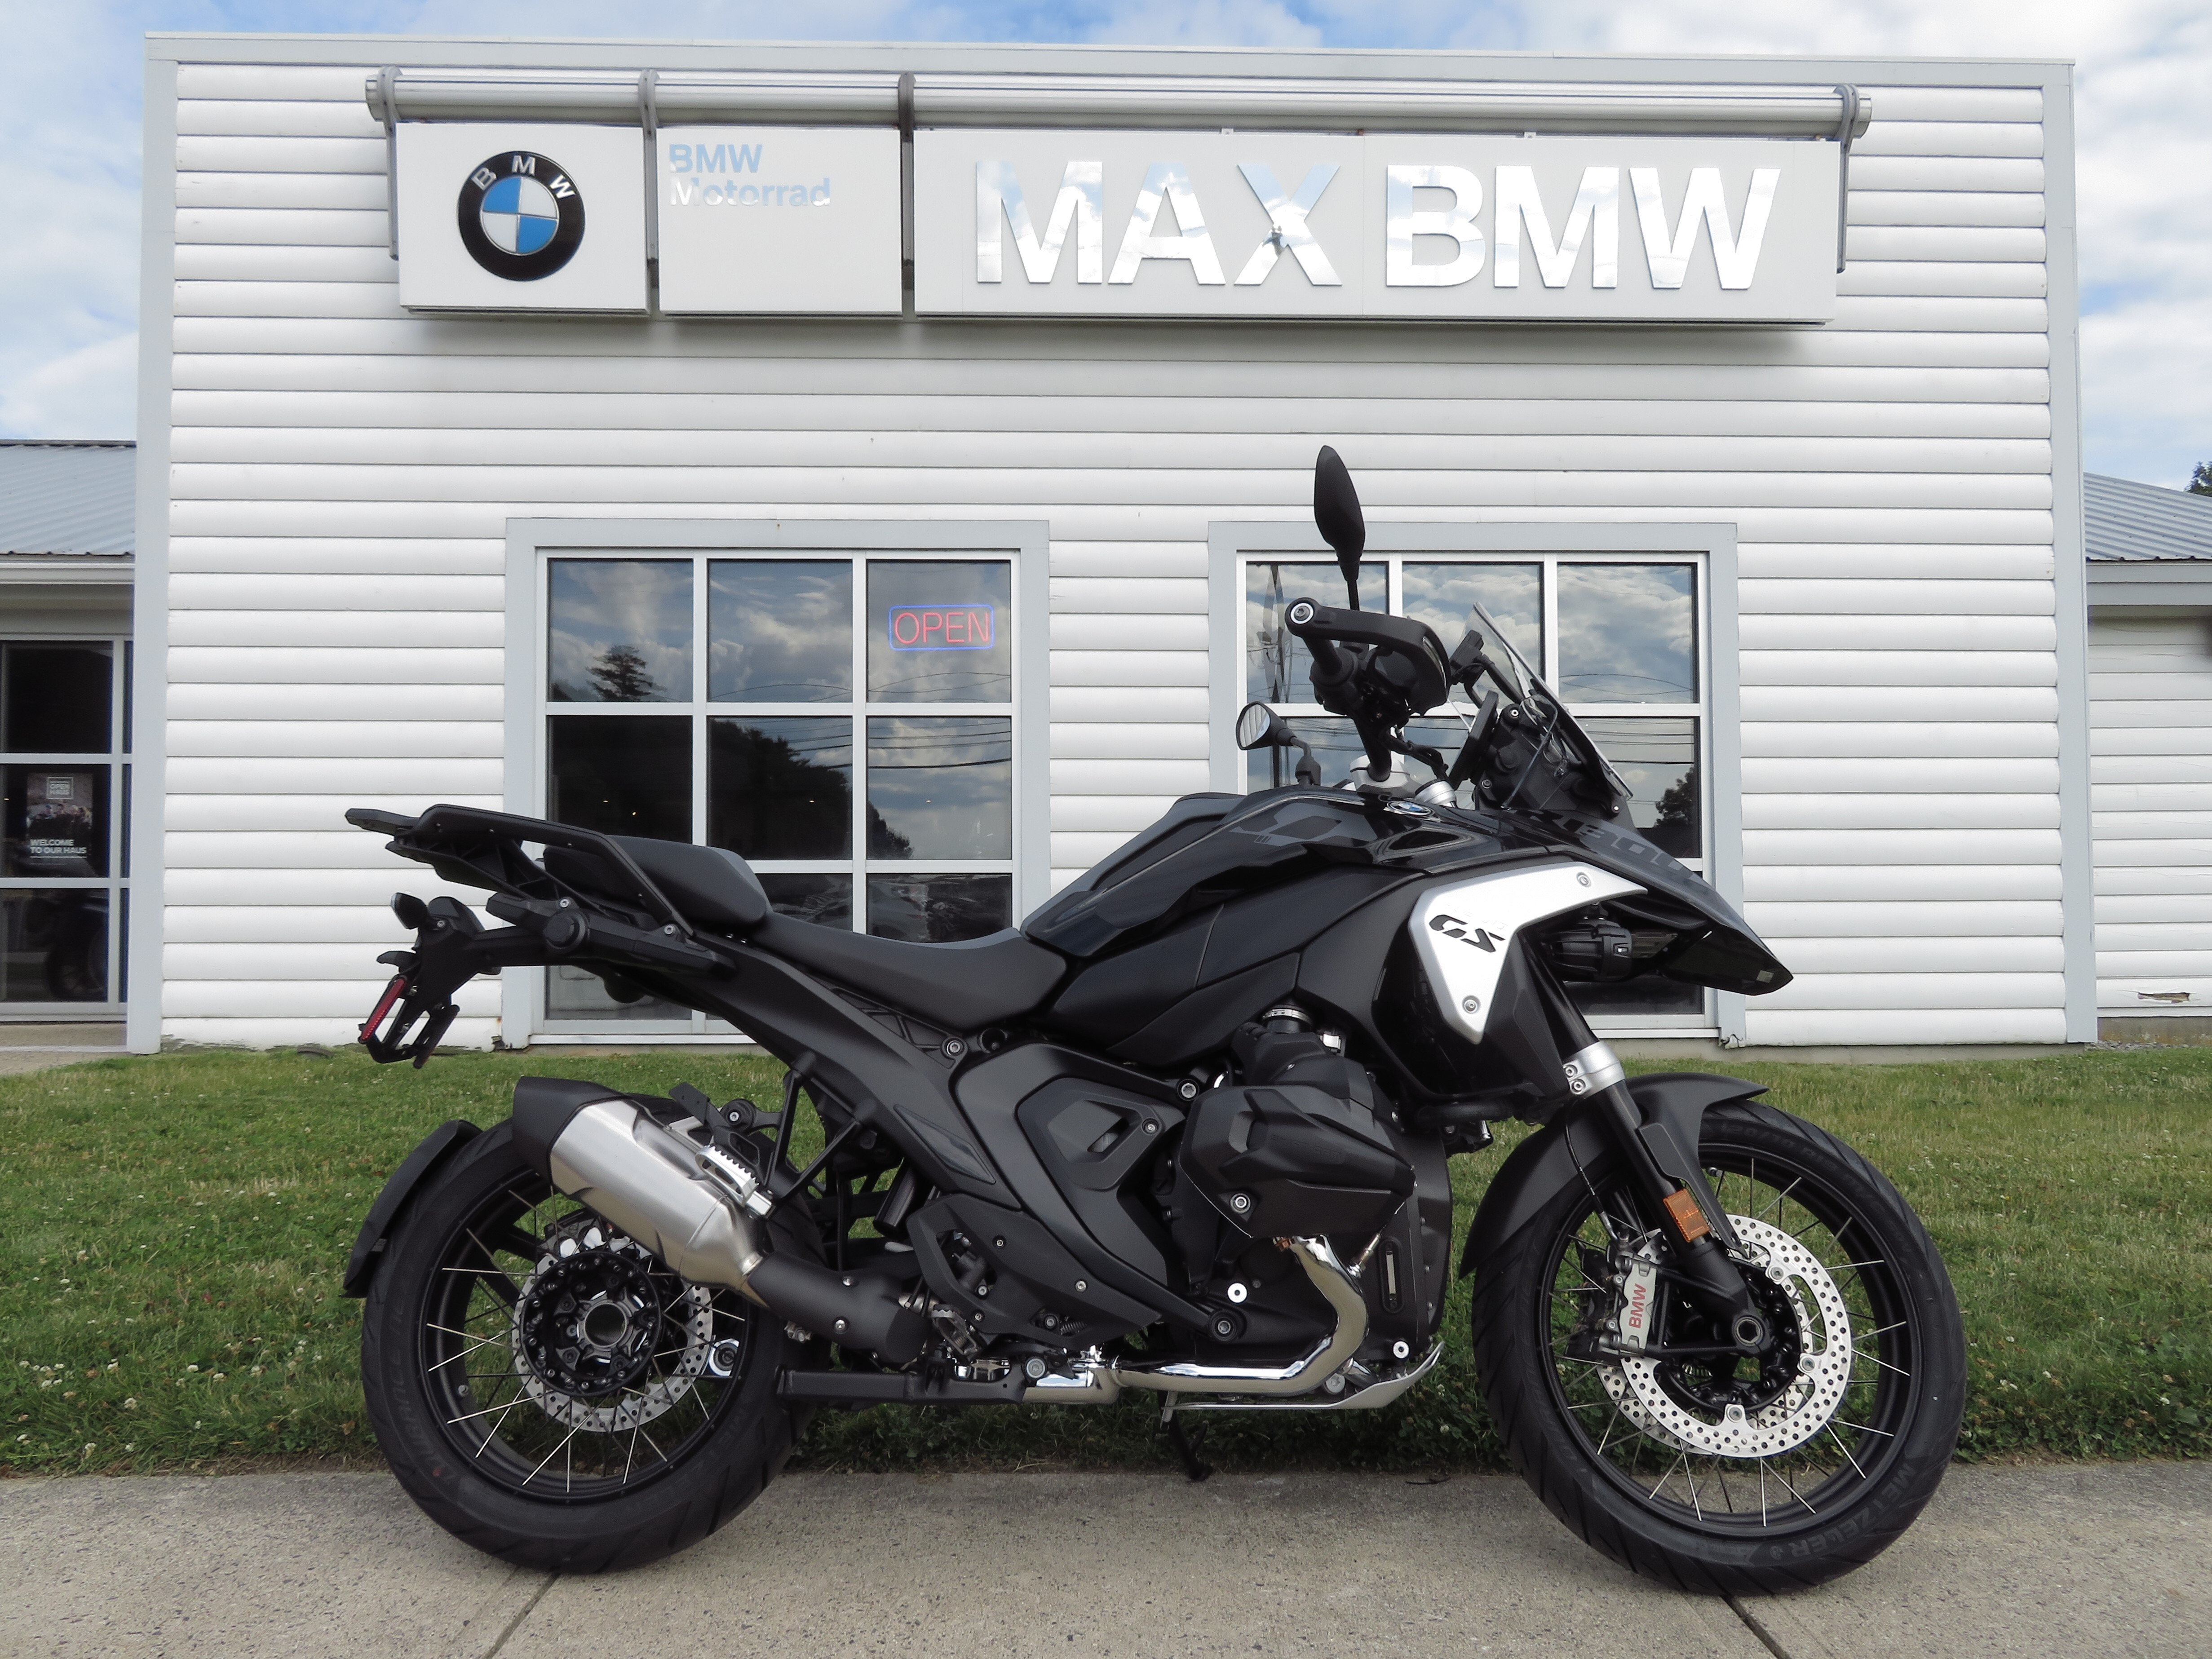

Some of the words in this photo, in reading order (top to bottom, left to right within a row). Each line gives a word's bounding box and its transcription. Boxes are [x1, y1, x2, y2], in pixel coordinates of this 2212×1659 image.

[472, 155, 575, 199] BMW
[669, 144, 763, 173] BMW
[670, 177, 831, 206] Motorrad
[976, 161, 1343, 288] MAX
[1385, 164, 1781, 291] BMW
[894, 611, 989, 645] OPEN
[1628, 1283, 1646, 1328] BMW
